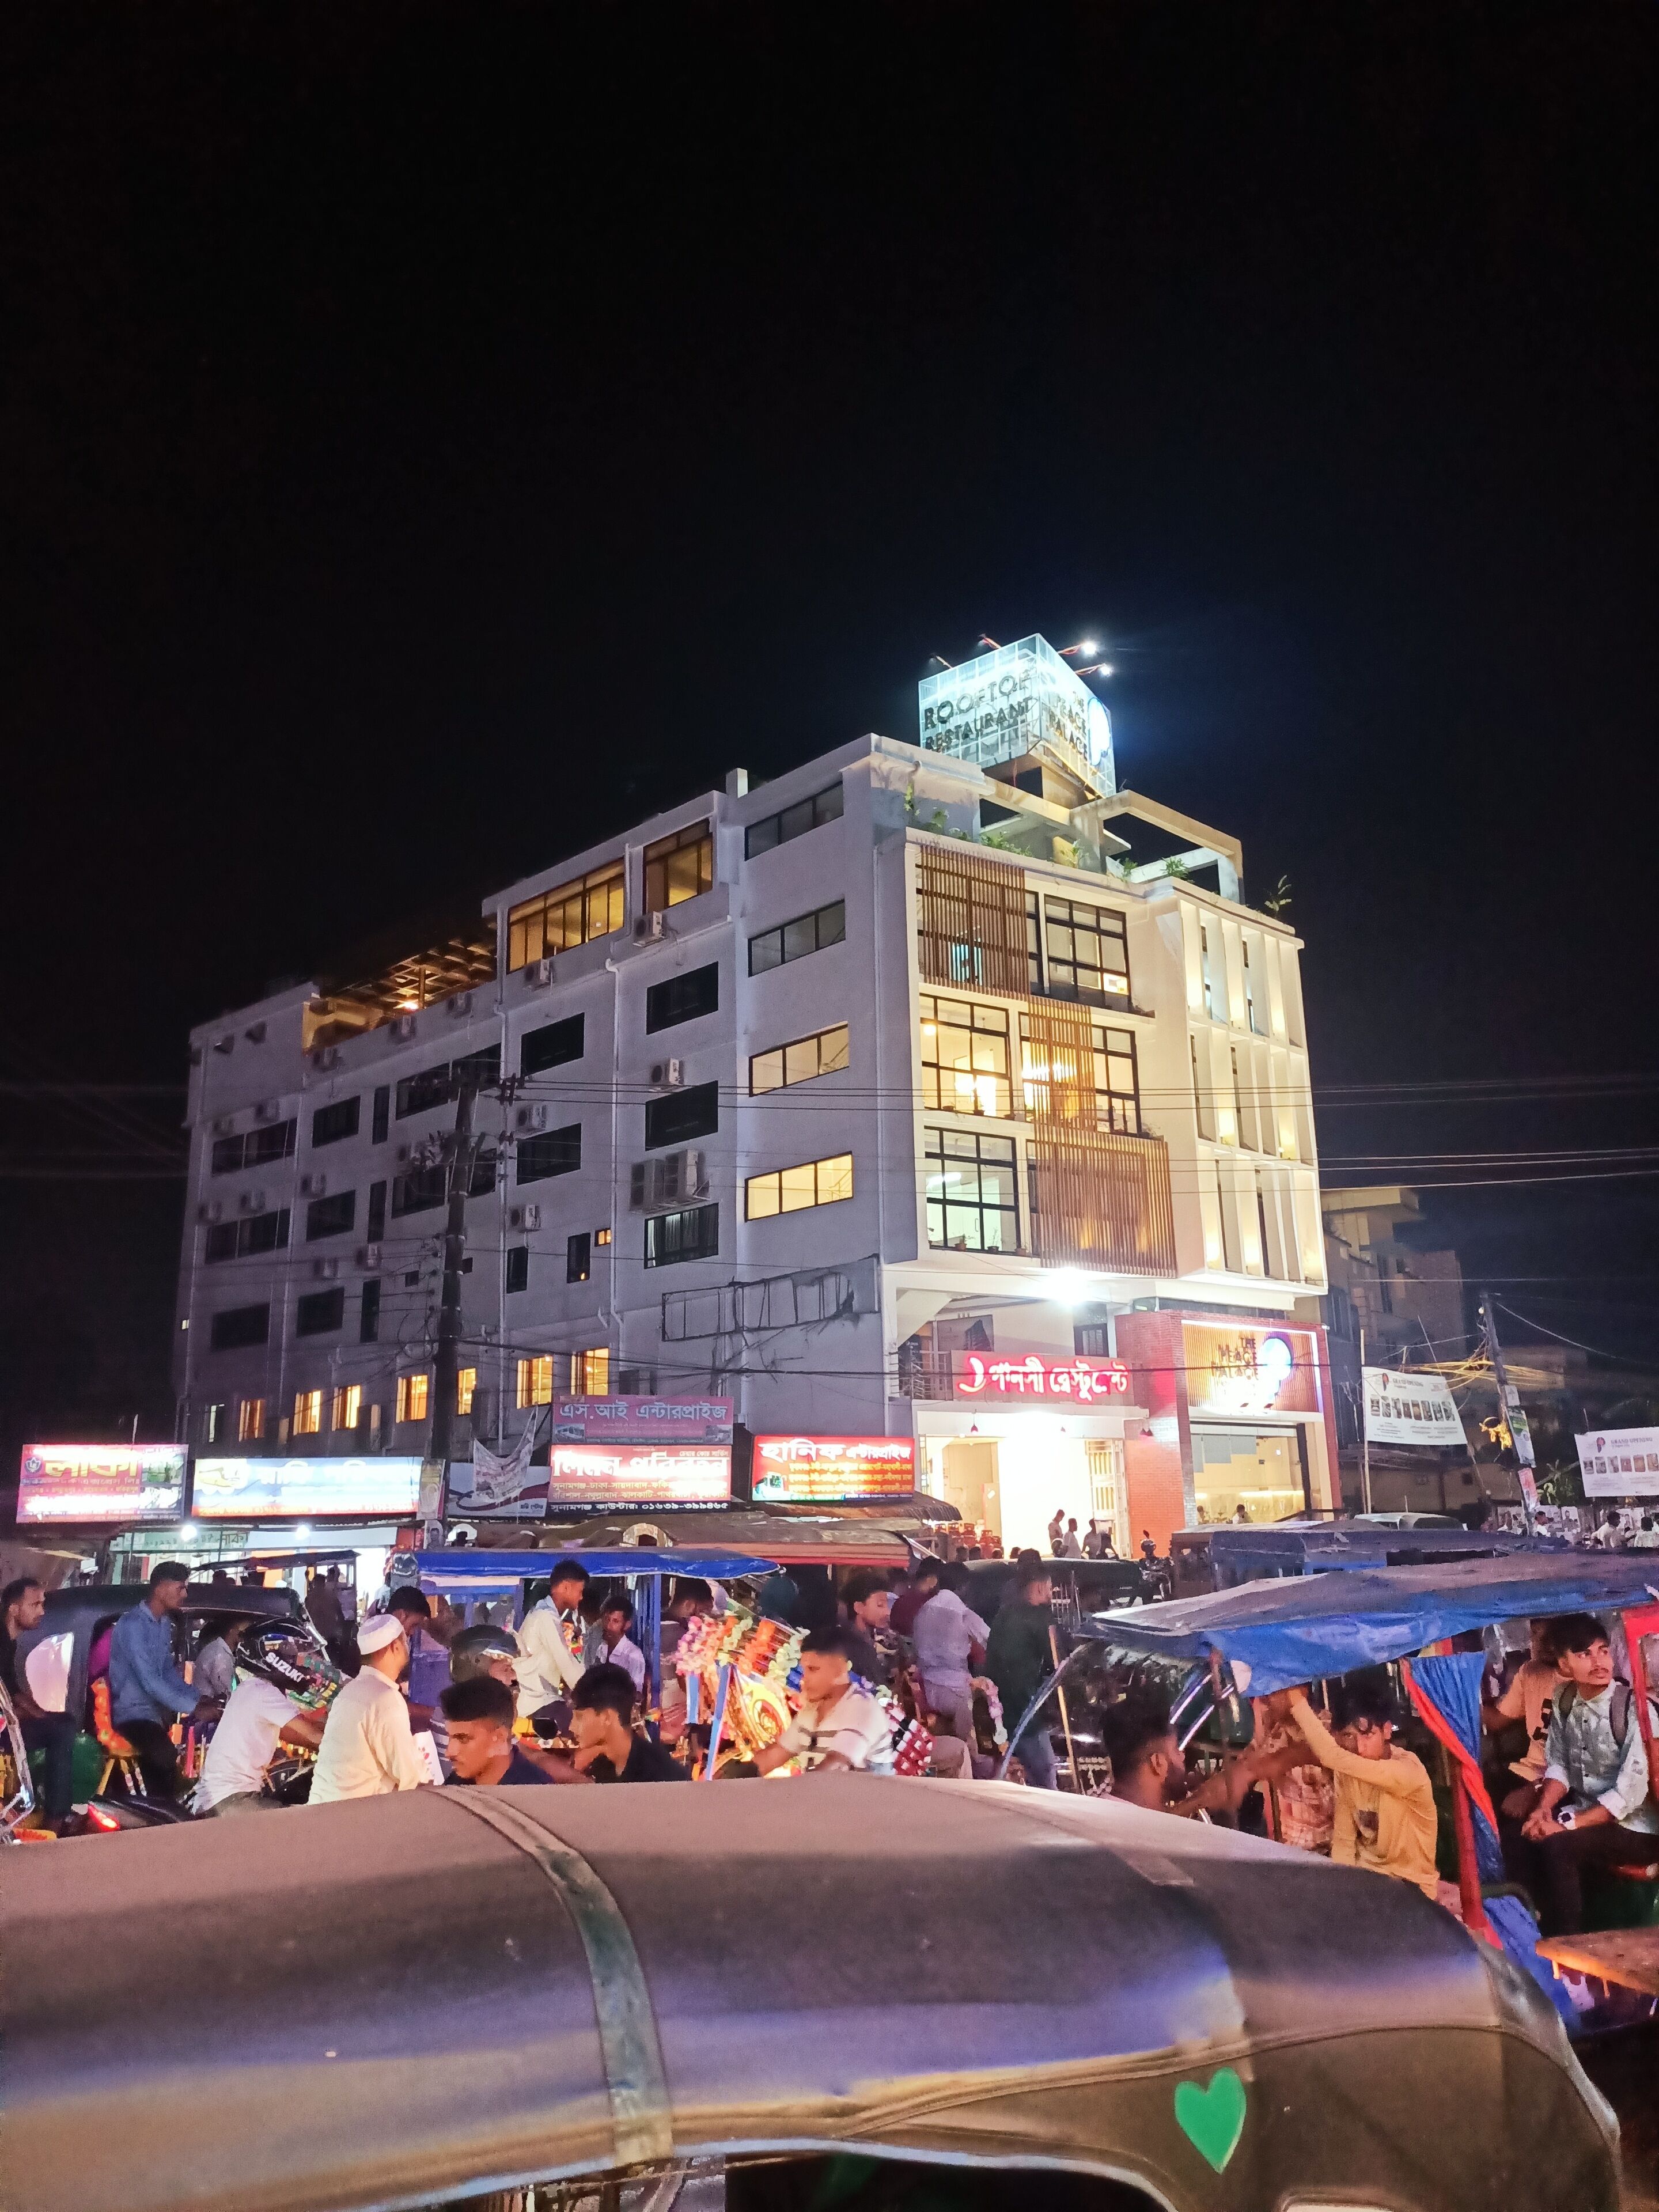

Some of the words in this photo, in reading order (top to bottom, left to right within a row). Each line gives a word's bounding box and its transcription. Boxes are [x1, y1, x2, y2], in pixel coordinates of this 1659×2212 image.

[924, 669, 1031, 731] ROOFTOP
[925, 695, 1033, 752] RESTAURANT
[1048, 710, 1088, 761] PALACE
[1240, 1337, 1256, 1349] THE
[636, 1401, 728, 1421] এন্টারপ্রাইজ
[757, 1438, 846, 1463] হানিফ
[266, 1652, 305, 1683] SUZUKI
